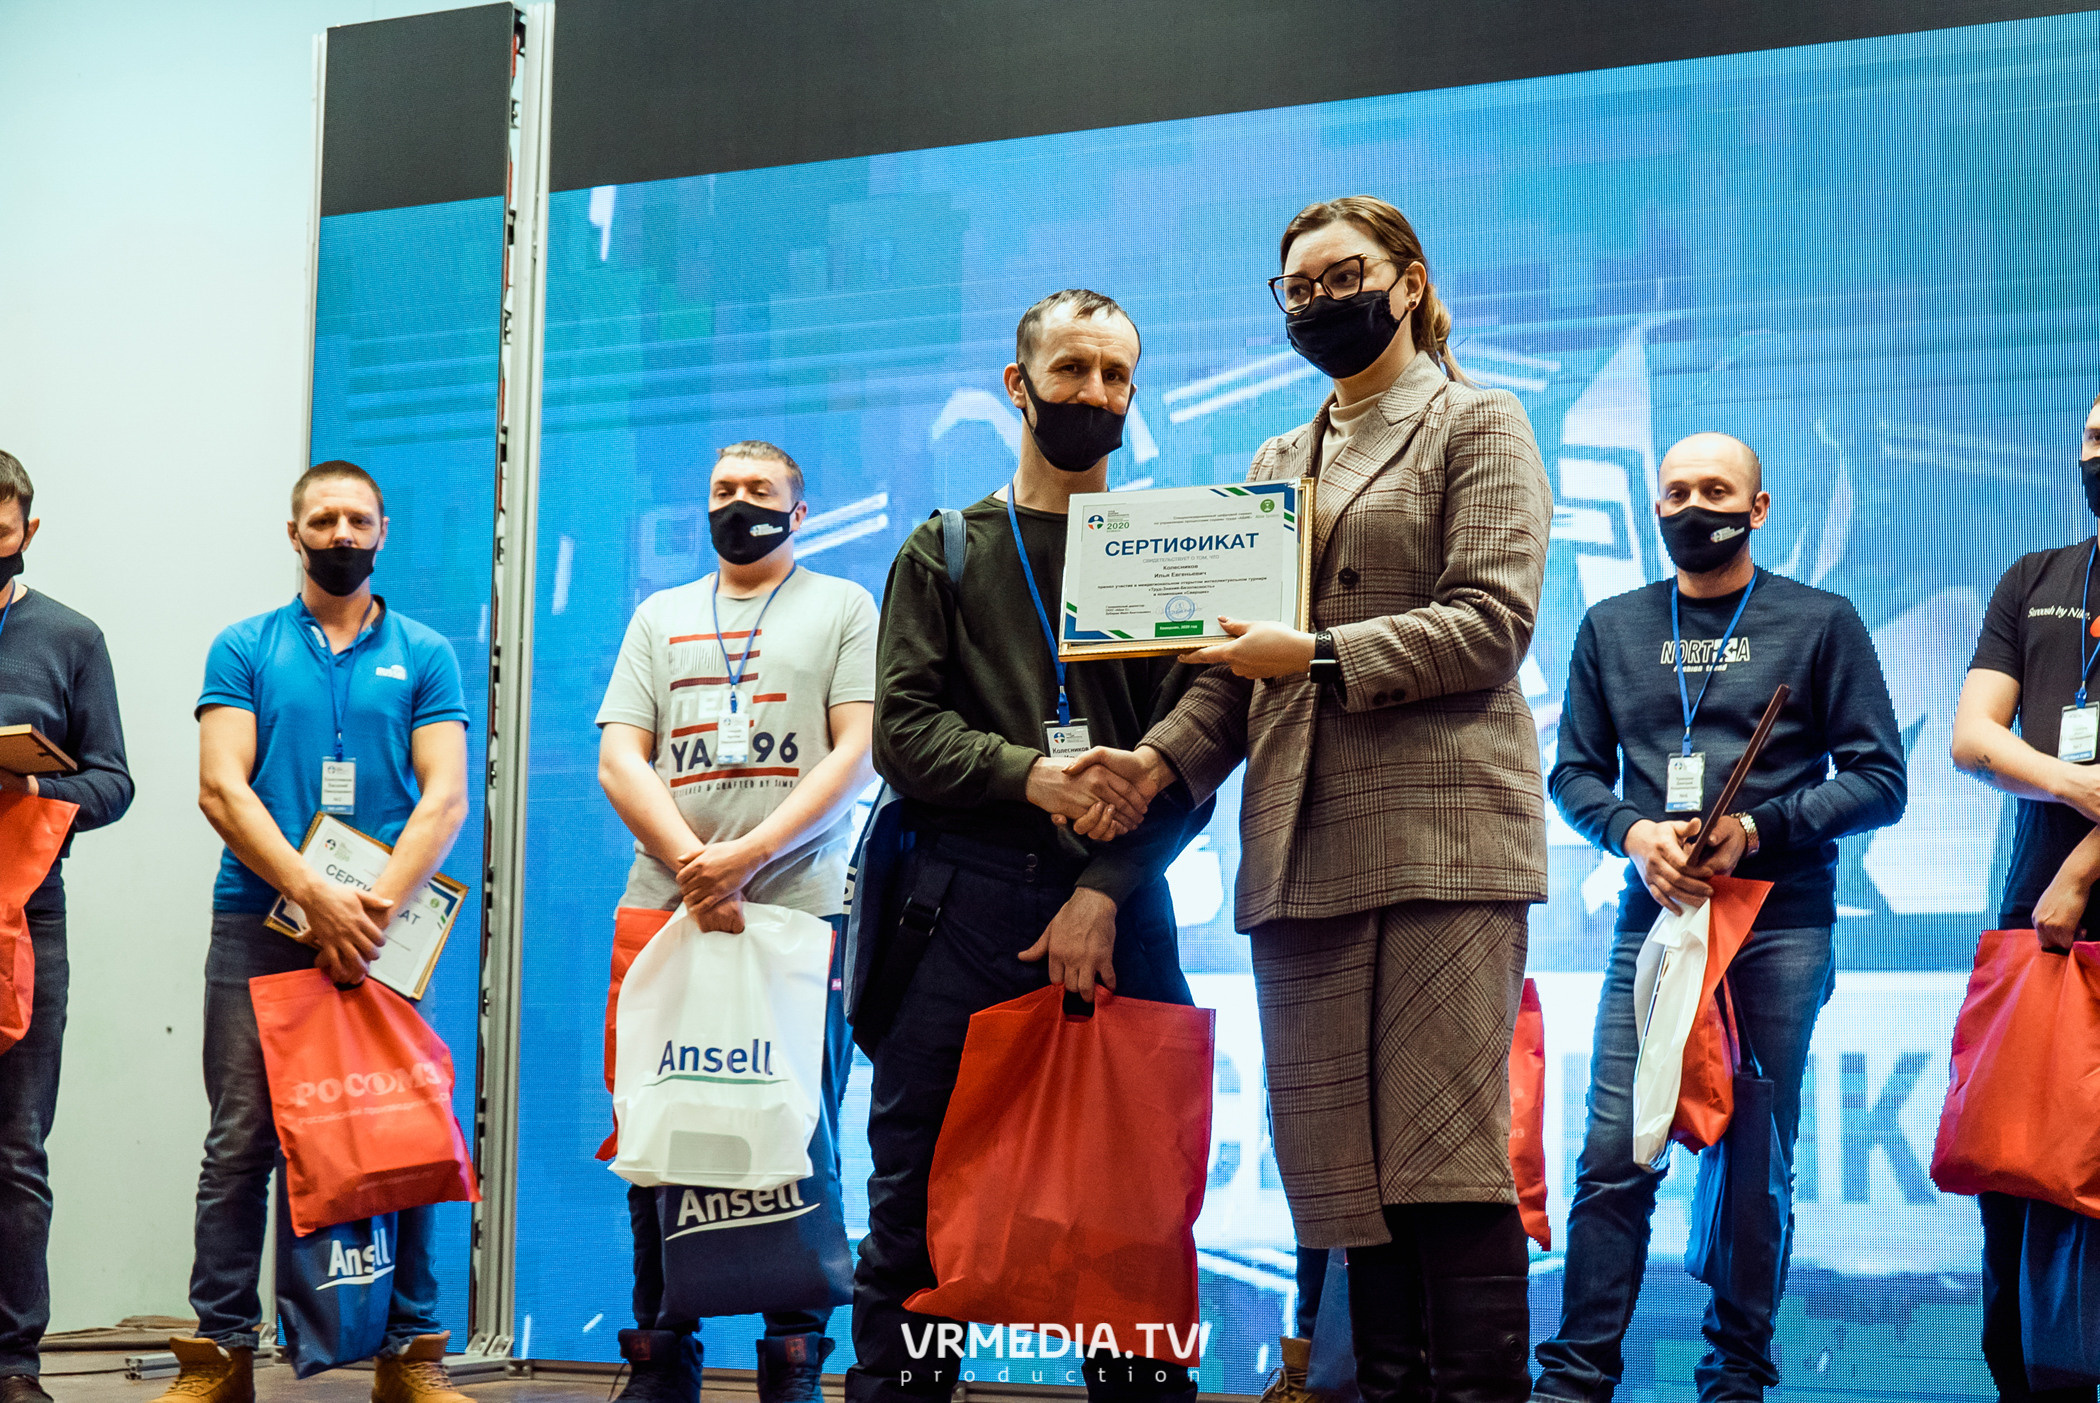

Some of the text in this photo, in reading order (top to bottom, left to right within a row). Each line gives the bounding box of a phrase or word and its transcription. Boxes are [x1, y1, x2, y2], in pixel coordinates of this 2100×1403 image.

[1106, 522, 1130, 530] 2020
[1105, 532, 1259, 556] СЕРТИФИКАТ
[716, 779, 754, 790] CRAFTED
[760, 779, 769, 788] BY
[657, 1038, 774, 1076] Ansell
[677, 1180, 805, 1227] Ansell
